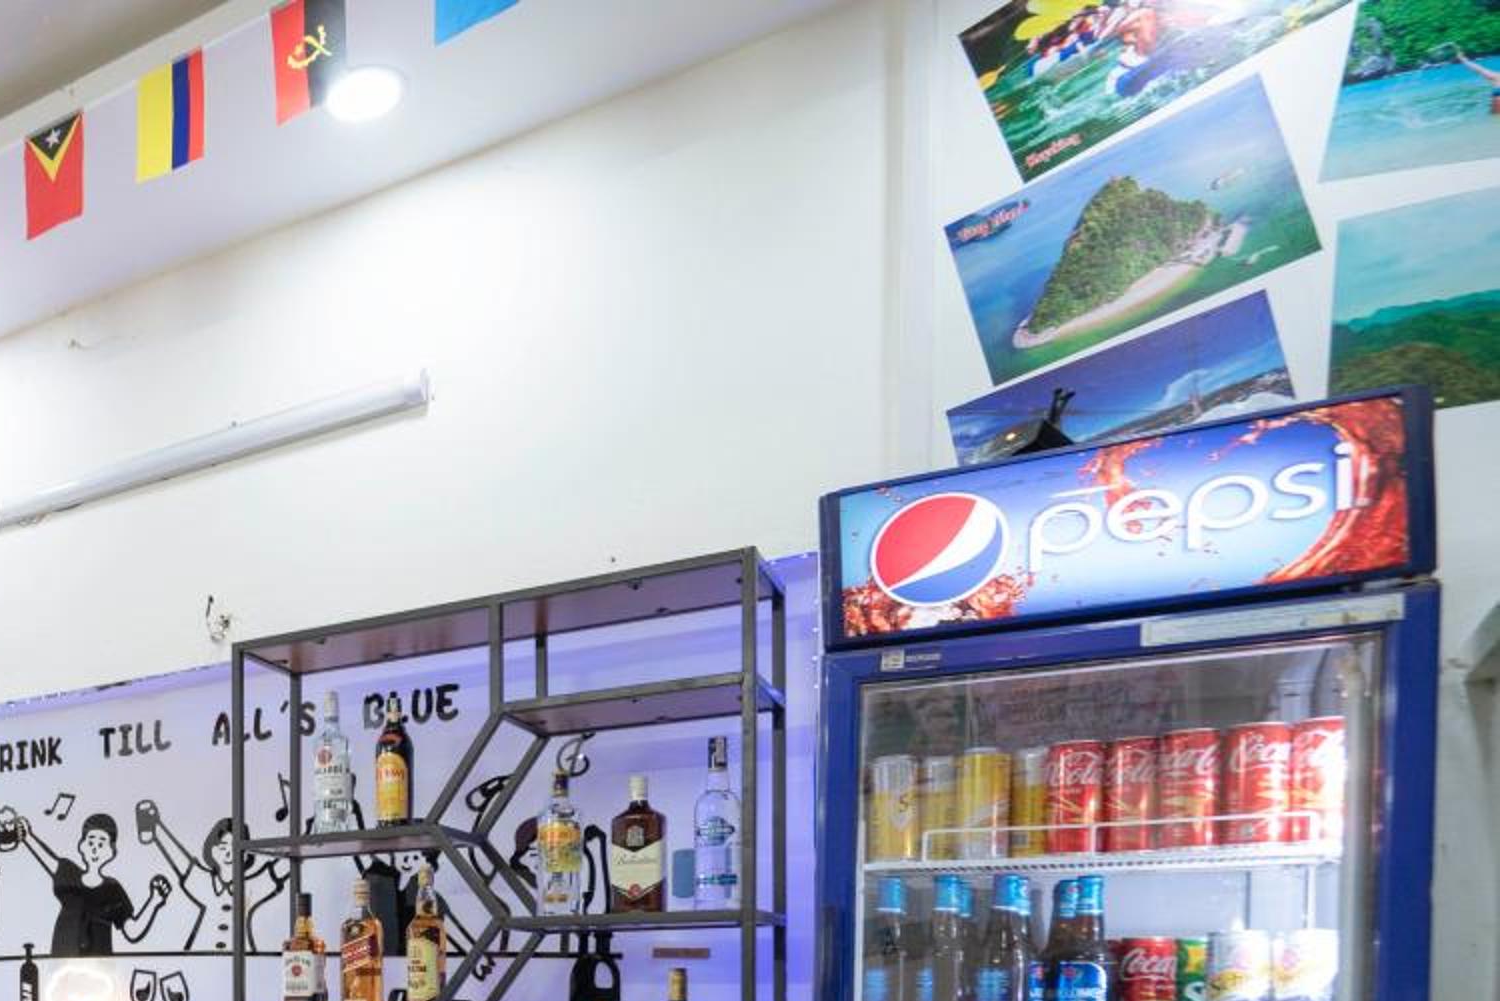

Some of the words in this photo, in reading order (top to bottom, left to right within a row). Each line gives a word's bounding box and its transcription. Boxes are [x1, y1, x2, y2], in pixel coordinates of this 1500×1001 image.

[1028, 441, 1356, 576] pepsi
[99, 719, 172, 758] TILL
[211, 700, 317, 746] AL'S
[362, 683, 460, 730] BUE
